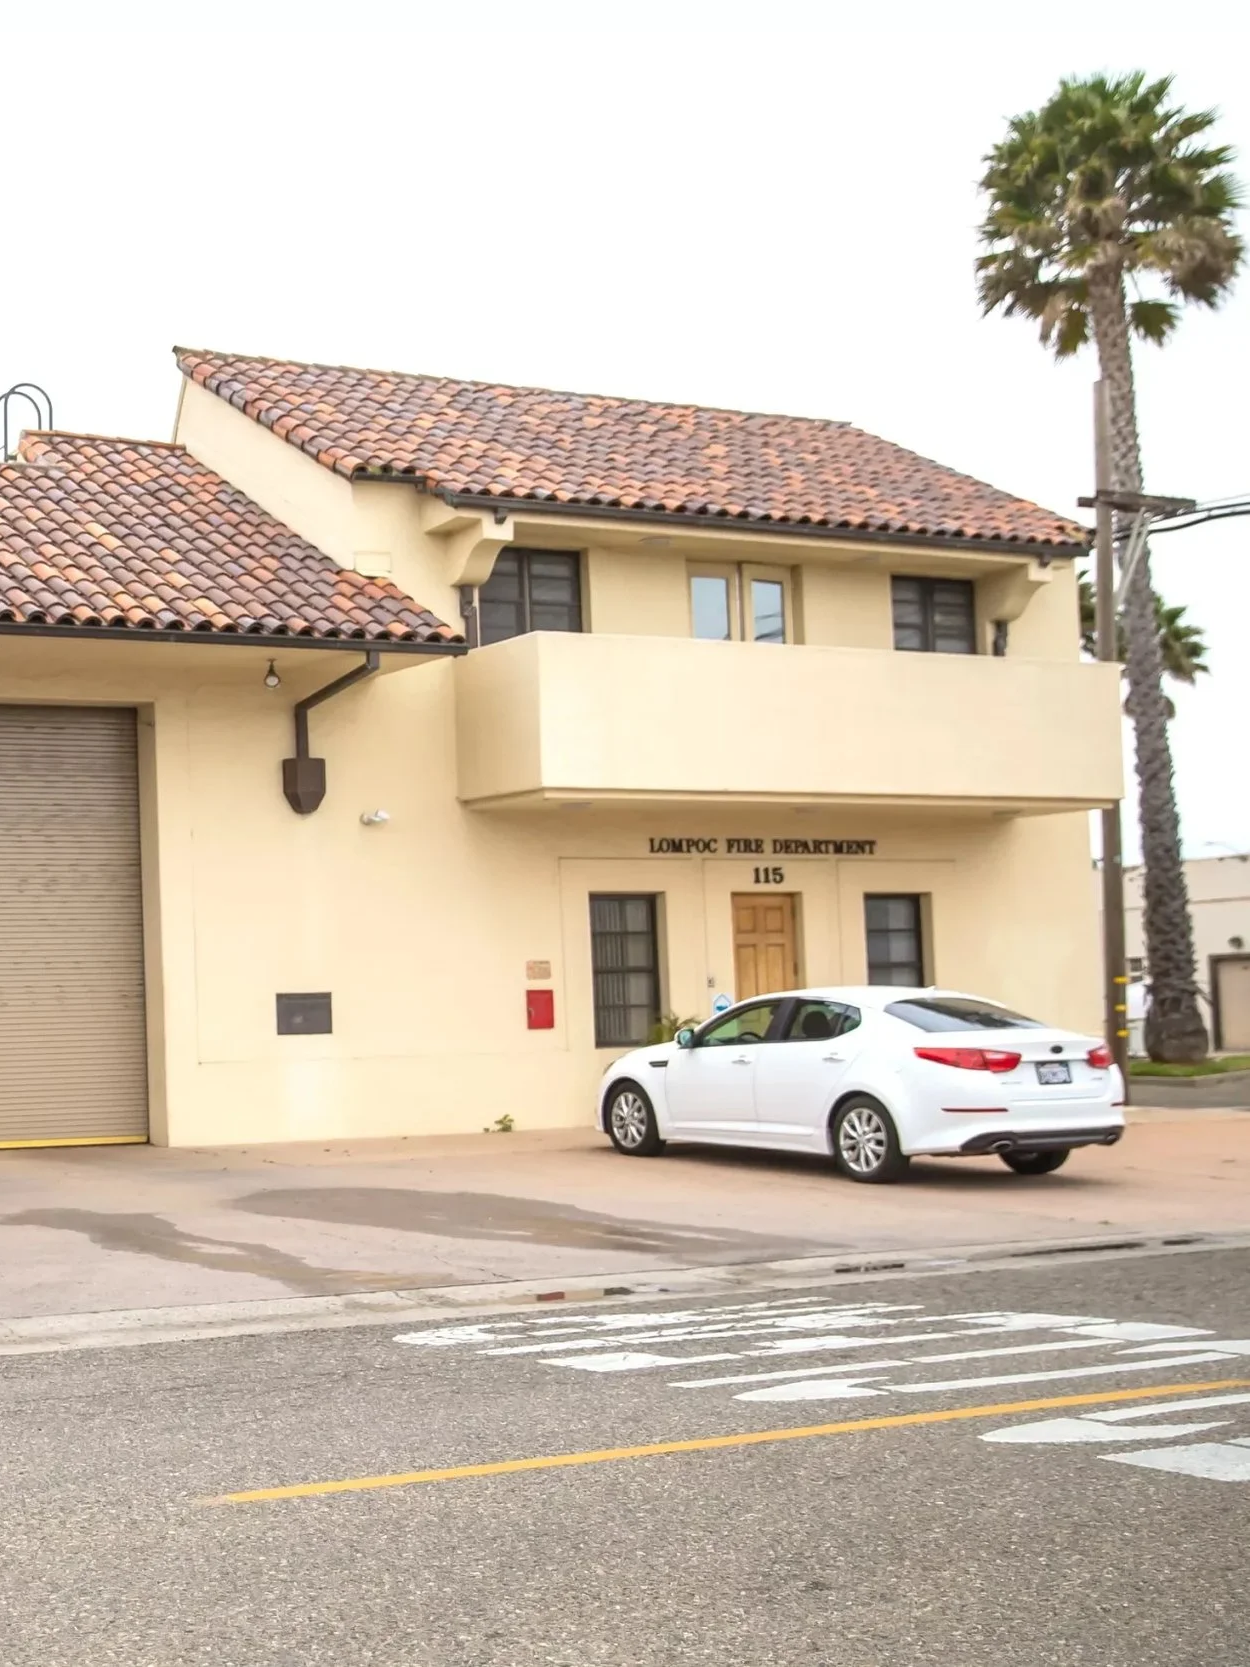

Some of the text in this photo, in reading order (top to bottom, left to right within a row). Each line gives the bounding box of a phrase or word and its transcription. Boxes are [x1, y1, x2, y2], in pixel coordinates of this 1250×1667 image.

[649, 838, 877, 855] LOMPOC FIRE DEPARTMENT
[753, 867, 784, 884] 115
